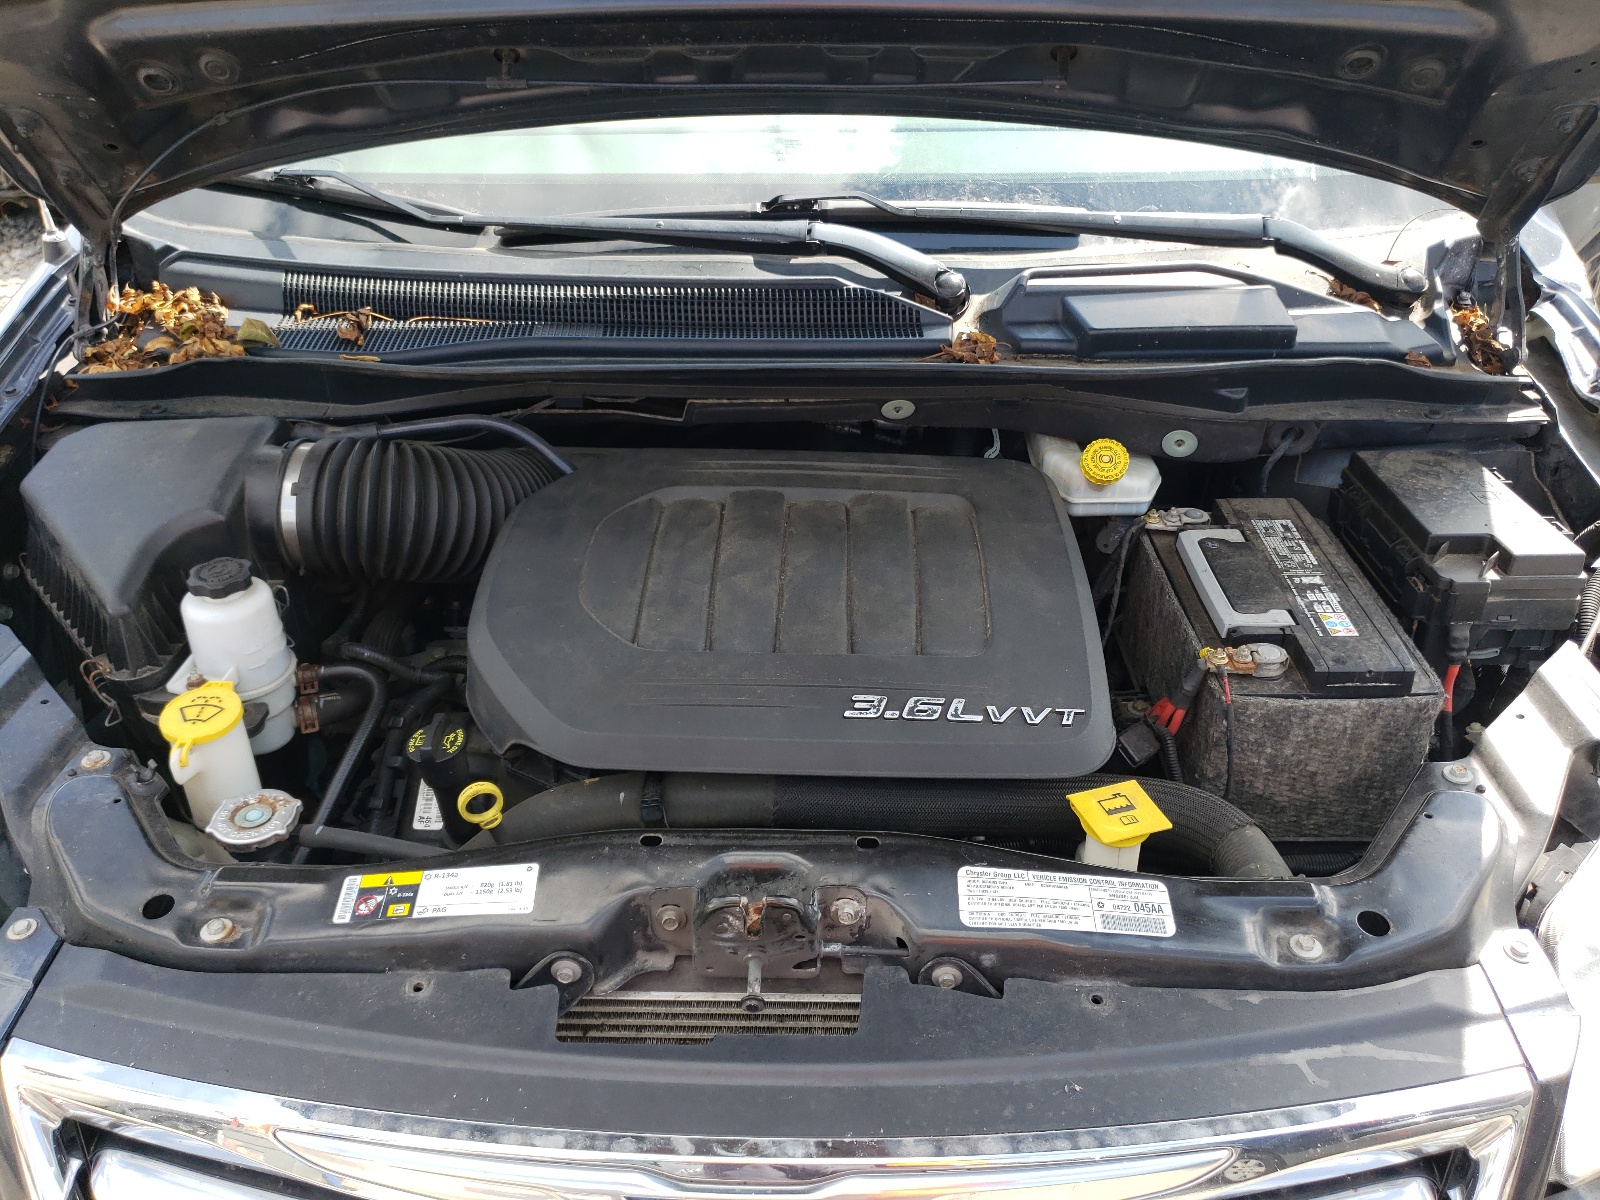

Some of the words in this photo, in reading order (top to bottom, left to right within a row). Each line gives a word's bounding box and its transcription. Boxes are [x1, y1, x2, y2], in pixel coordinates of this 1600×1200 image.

[434, 871, 459, 879] R-134a
[965, 869, 992, 877] Chrysler
[993, 870, 1012, 879] Group
[1031, 873, 1057, 882] VEHICLE
[1058, 875, 1088, 884] EMISSION
[1089, 878, 1117, 887] CONTROL
[1118, 880, 1159, 890] INFORMATION
[431, 906, 447, 914] PAG
[1112, 903, 1132, 912] 04722
[1133, 902, 1165, 914] 045AA
